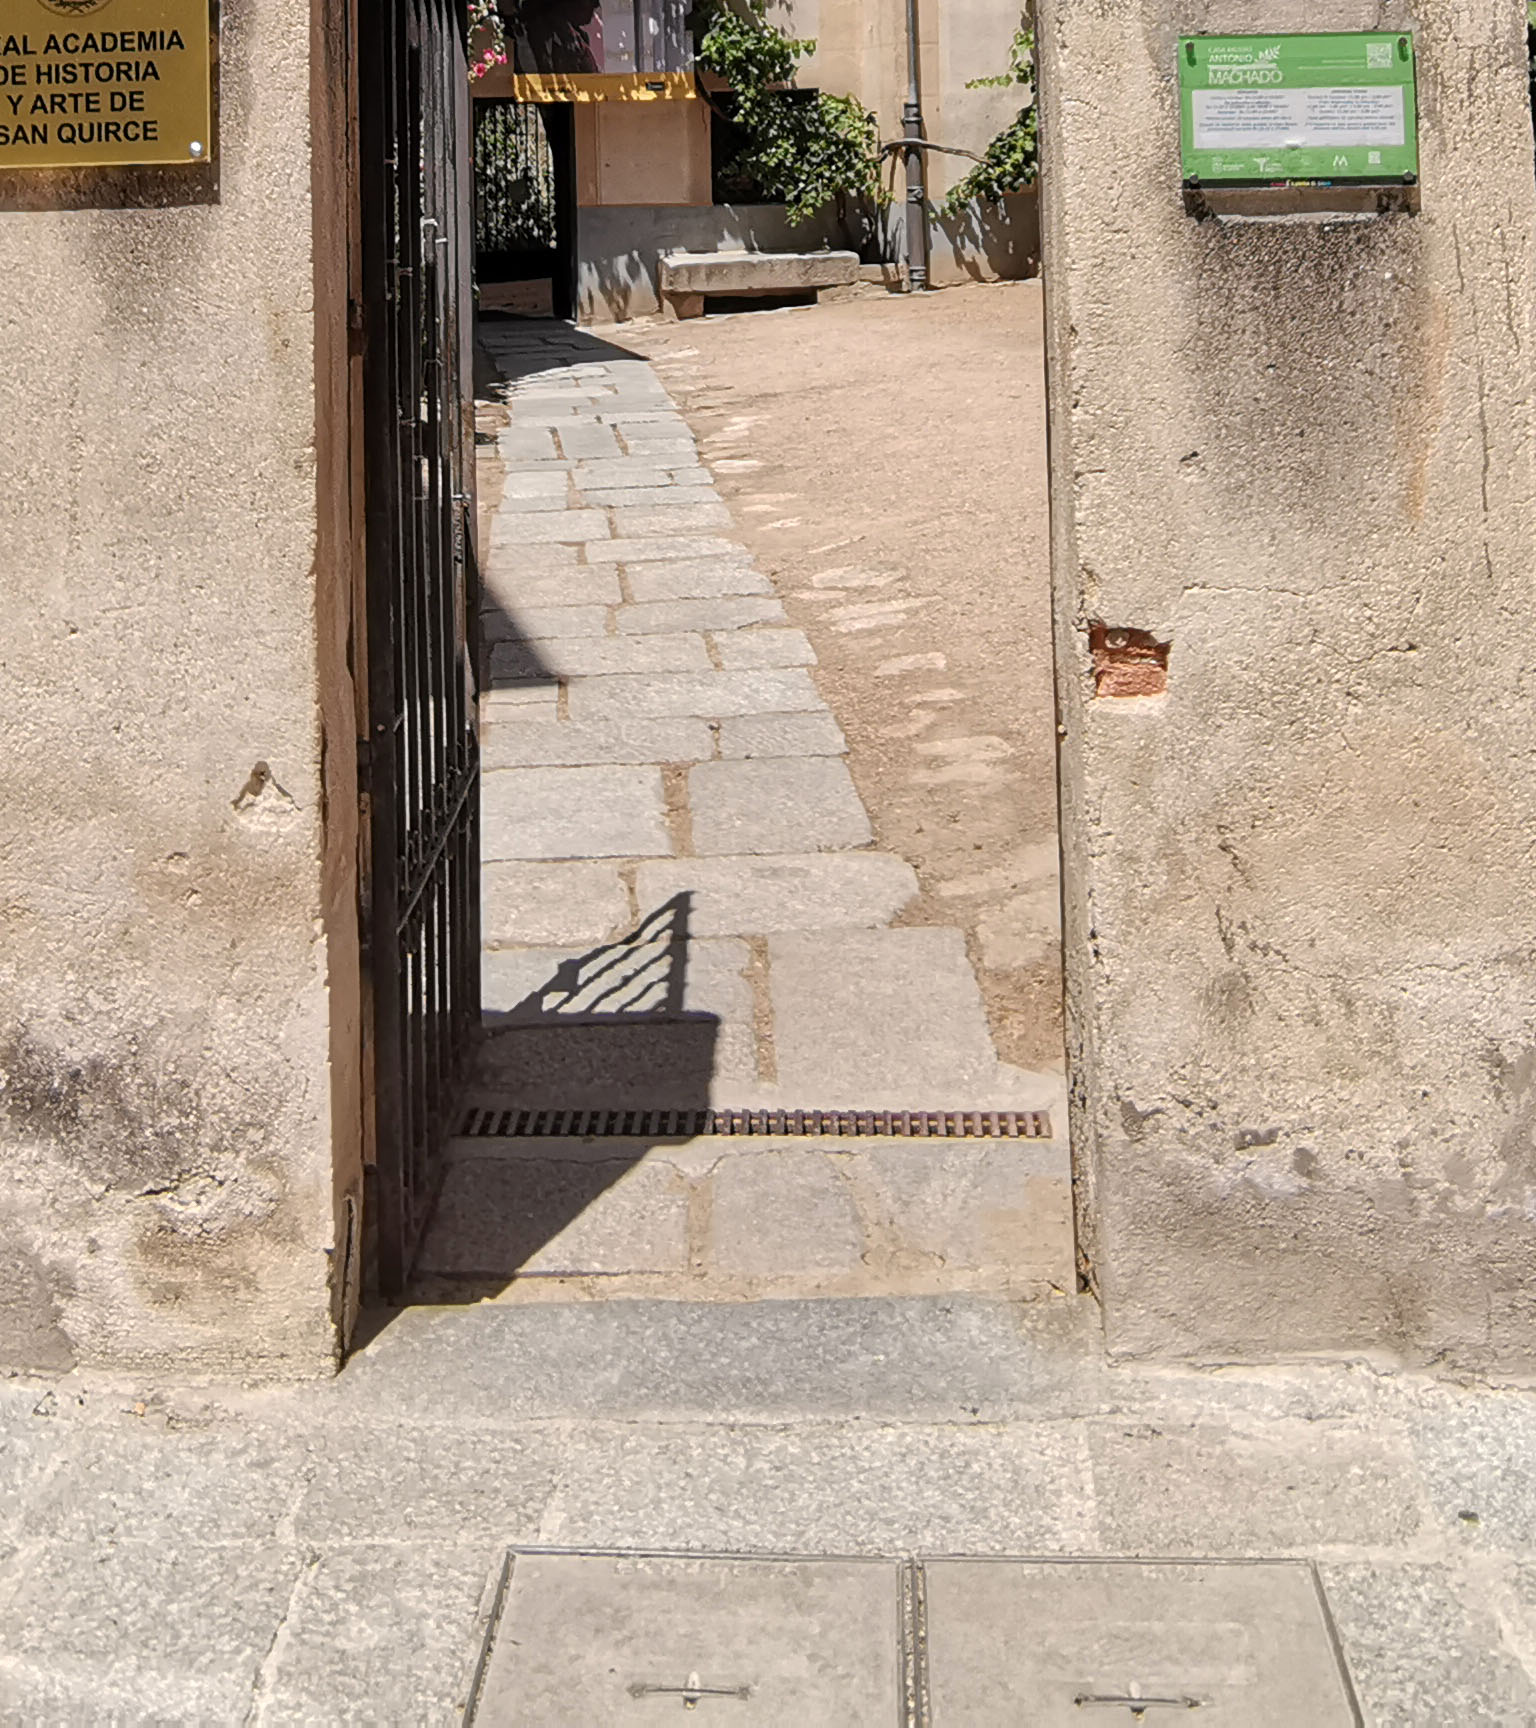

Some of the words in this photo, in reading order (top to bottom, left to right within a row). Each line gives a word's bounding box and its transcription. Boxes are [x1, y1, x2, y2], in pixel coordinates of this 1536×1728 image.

[42, 29, 185, 56] ACADEMIA
[35, 60, 161, 85] HISTORIA
[1208, 70, 1283, 85] MACHADO
[6, 94, 24, 116] Y
[29, 91, 101, 115] ARTE
[109, 90, 145, 113] DE
[56, 119, 159, 145] QUIRCE
